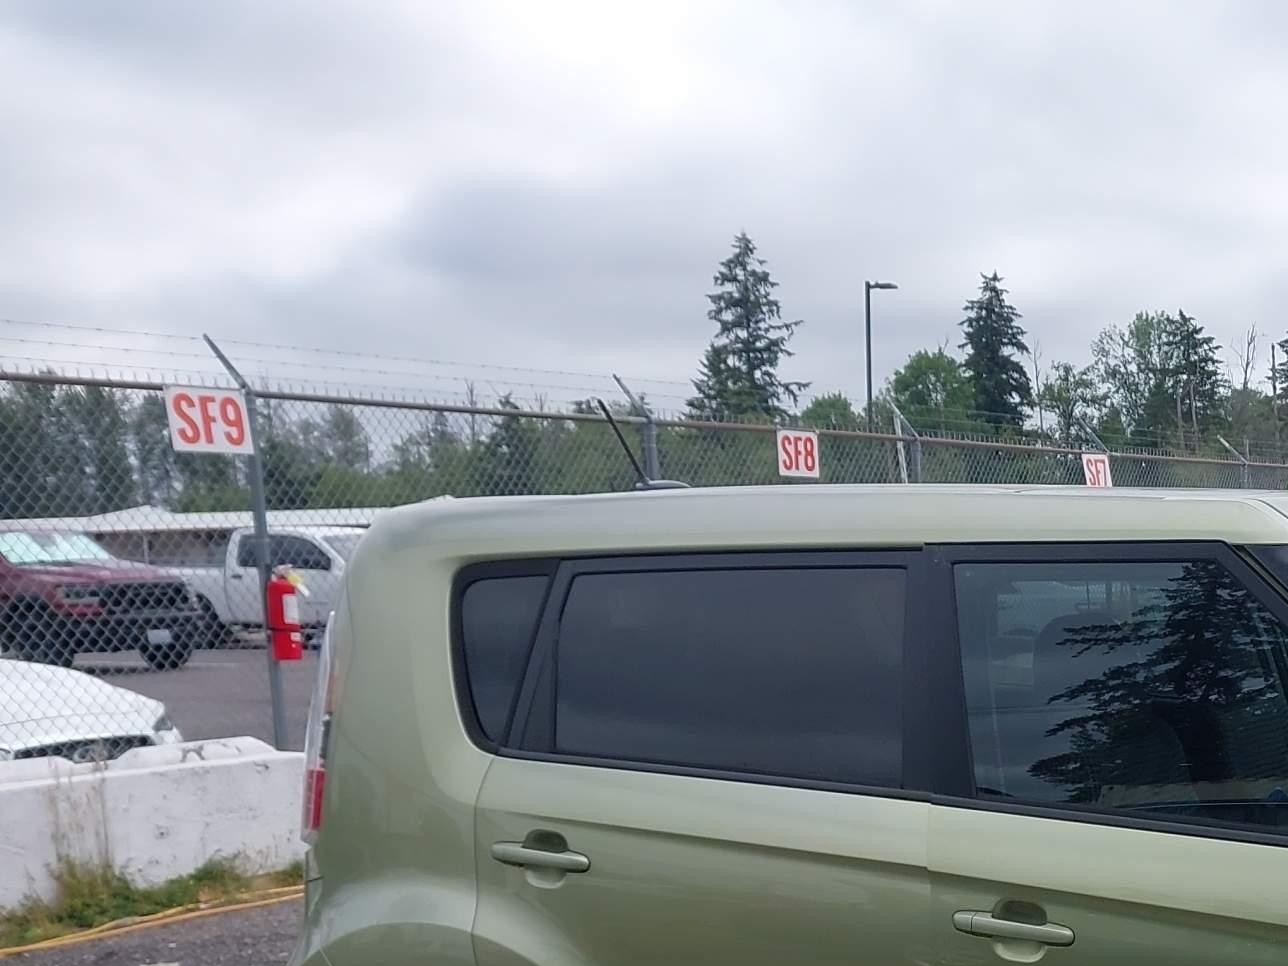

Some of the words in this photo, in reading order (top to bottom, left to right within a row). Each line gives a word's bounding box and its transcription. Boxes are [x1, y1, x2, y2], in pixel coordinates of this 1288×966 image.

[172, 393, 245, 446] SF9
[781, 435, 815, 471] SF8
[1086, 458, 1107, 486] SF7
